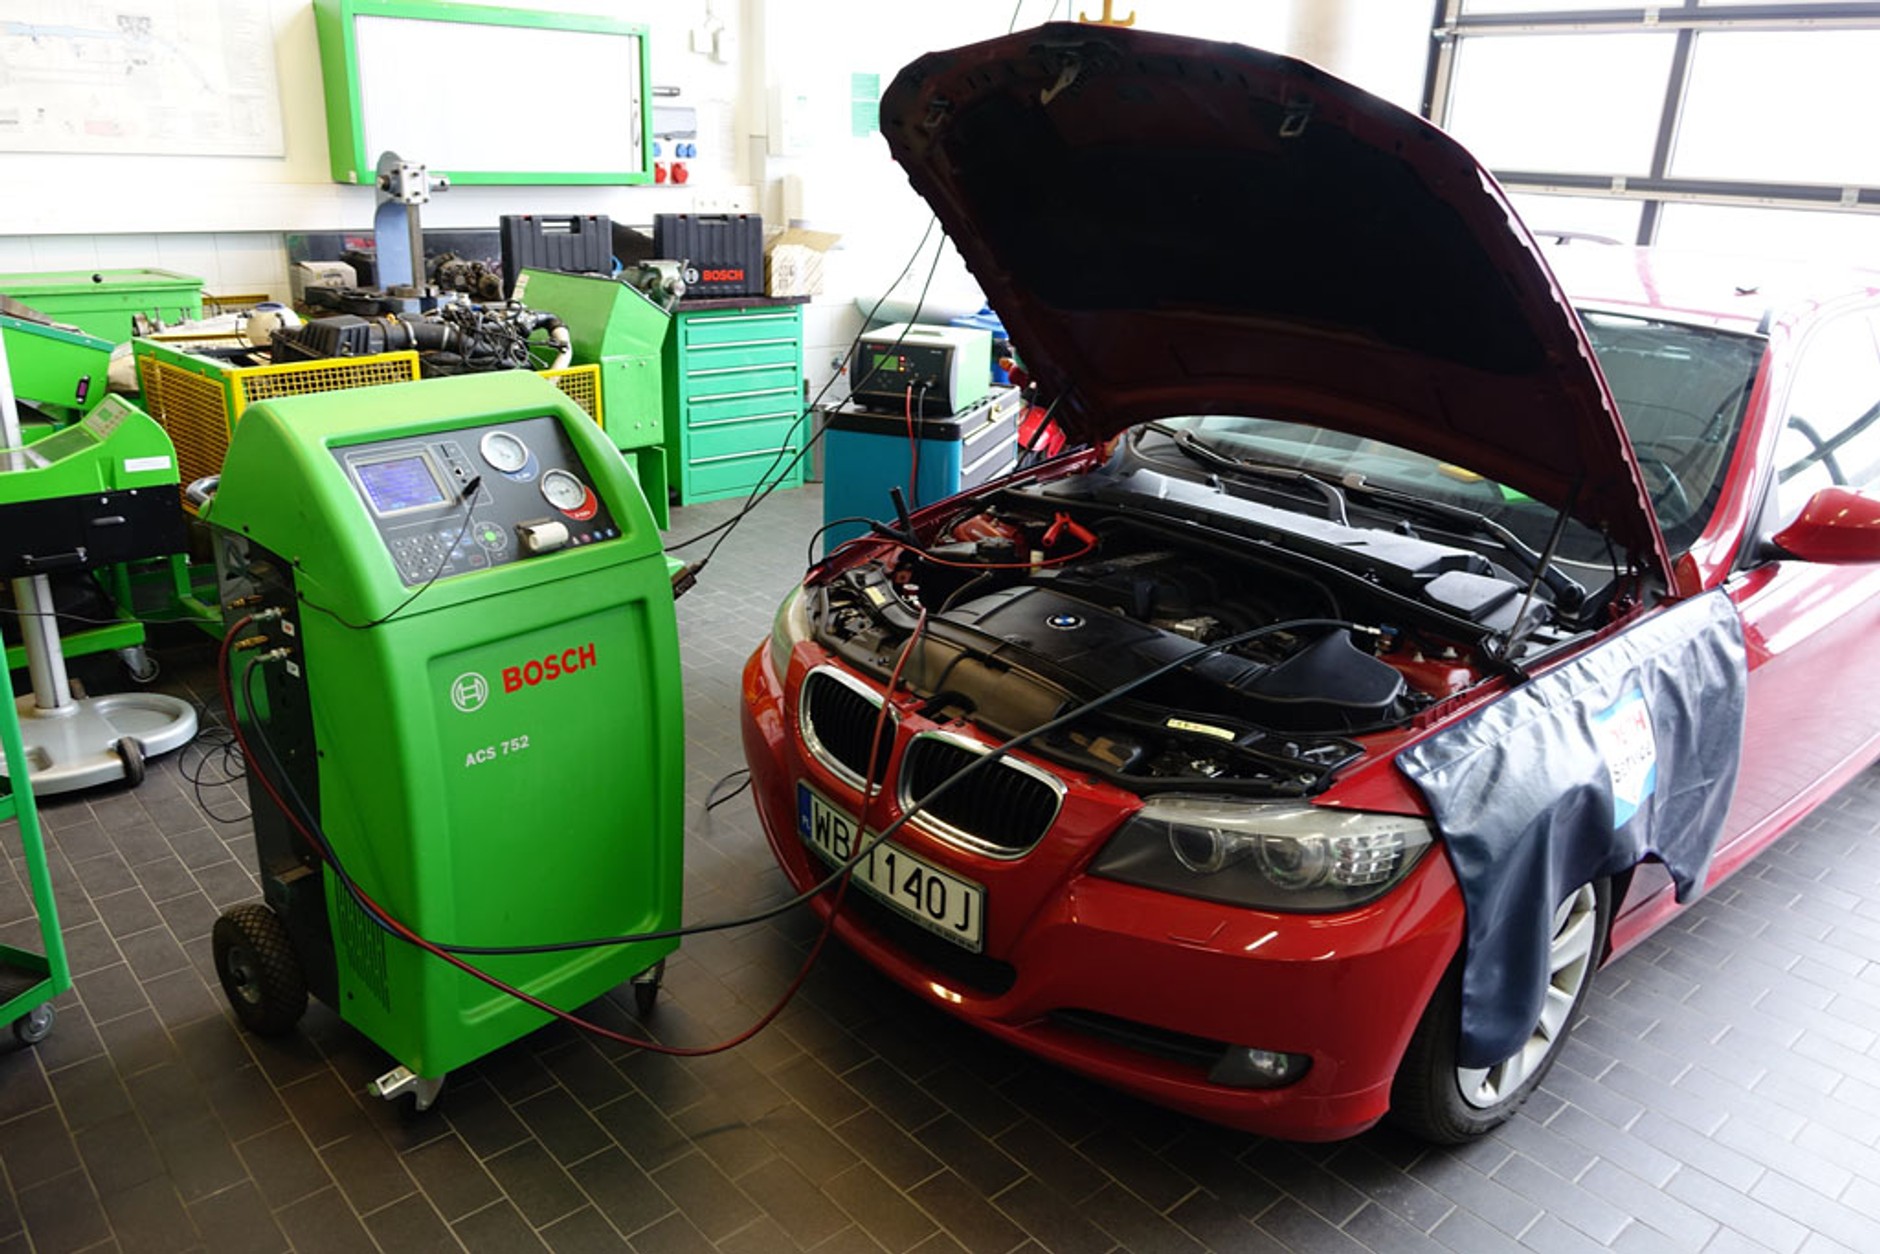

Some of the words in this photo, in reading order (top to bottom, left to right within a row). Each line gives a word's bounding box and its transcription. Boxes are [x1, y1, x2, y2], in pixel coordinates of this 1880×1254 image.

[702, 269, 744, 281] BOSCH
[501, 642, 597, 694] BOSCH
[465, 746, 497, 767] ACS
[500, 734, 530, 755] 752
[814, 801, 850, 863] WB
